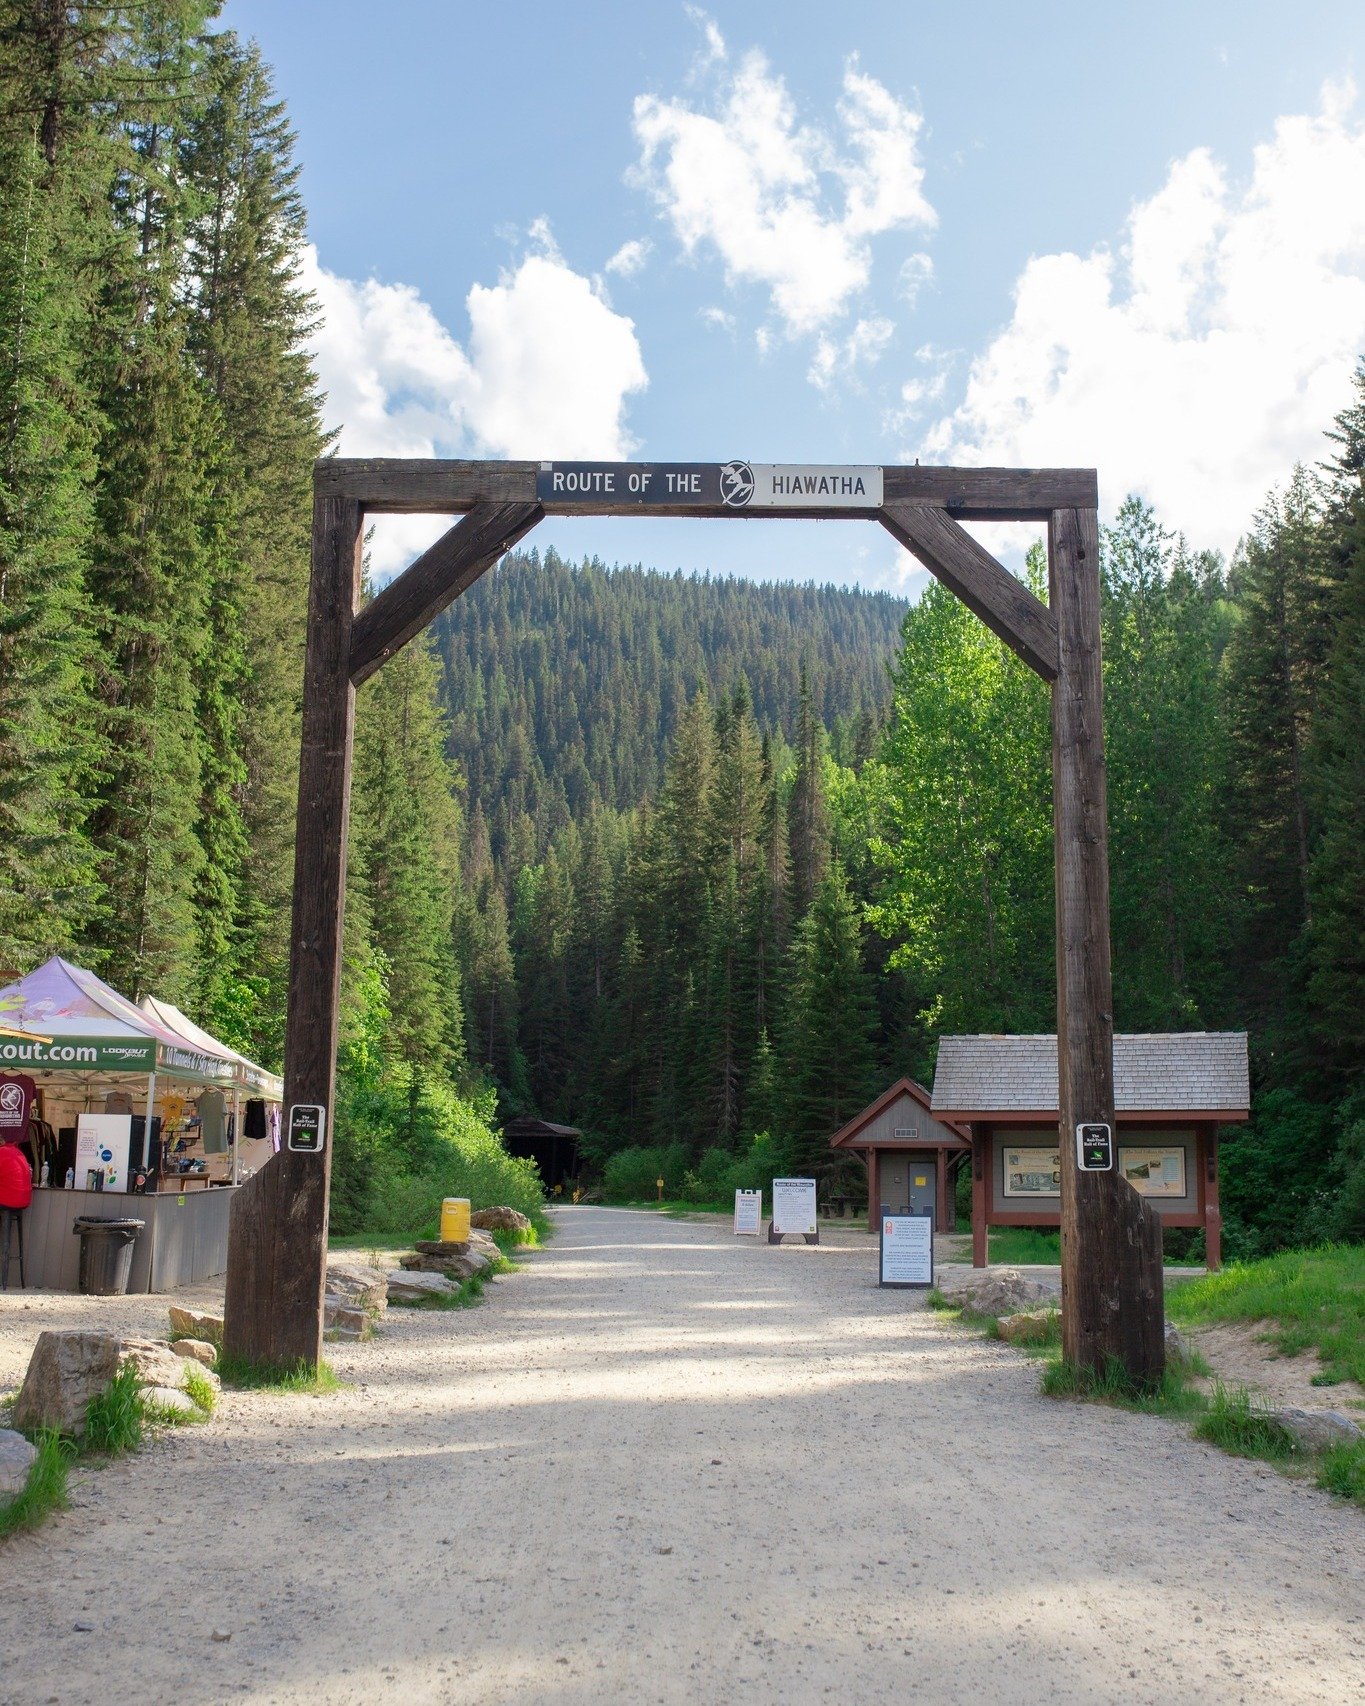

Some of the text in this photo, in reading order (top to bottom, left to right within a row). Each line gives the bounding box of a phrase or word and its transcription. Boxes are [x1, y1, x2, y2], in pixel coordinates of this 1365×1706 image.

[553, 472, 866, 496] ROUTE OF THE HIAWATHA
[0, 1041, 98, 1062] out.com
